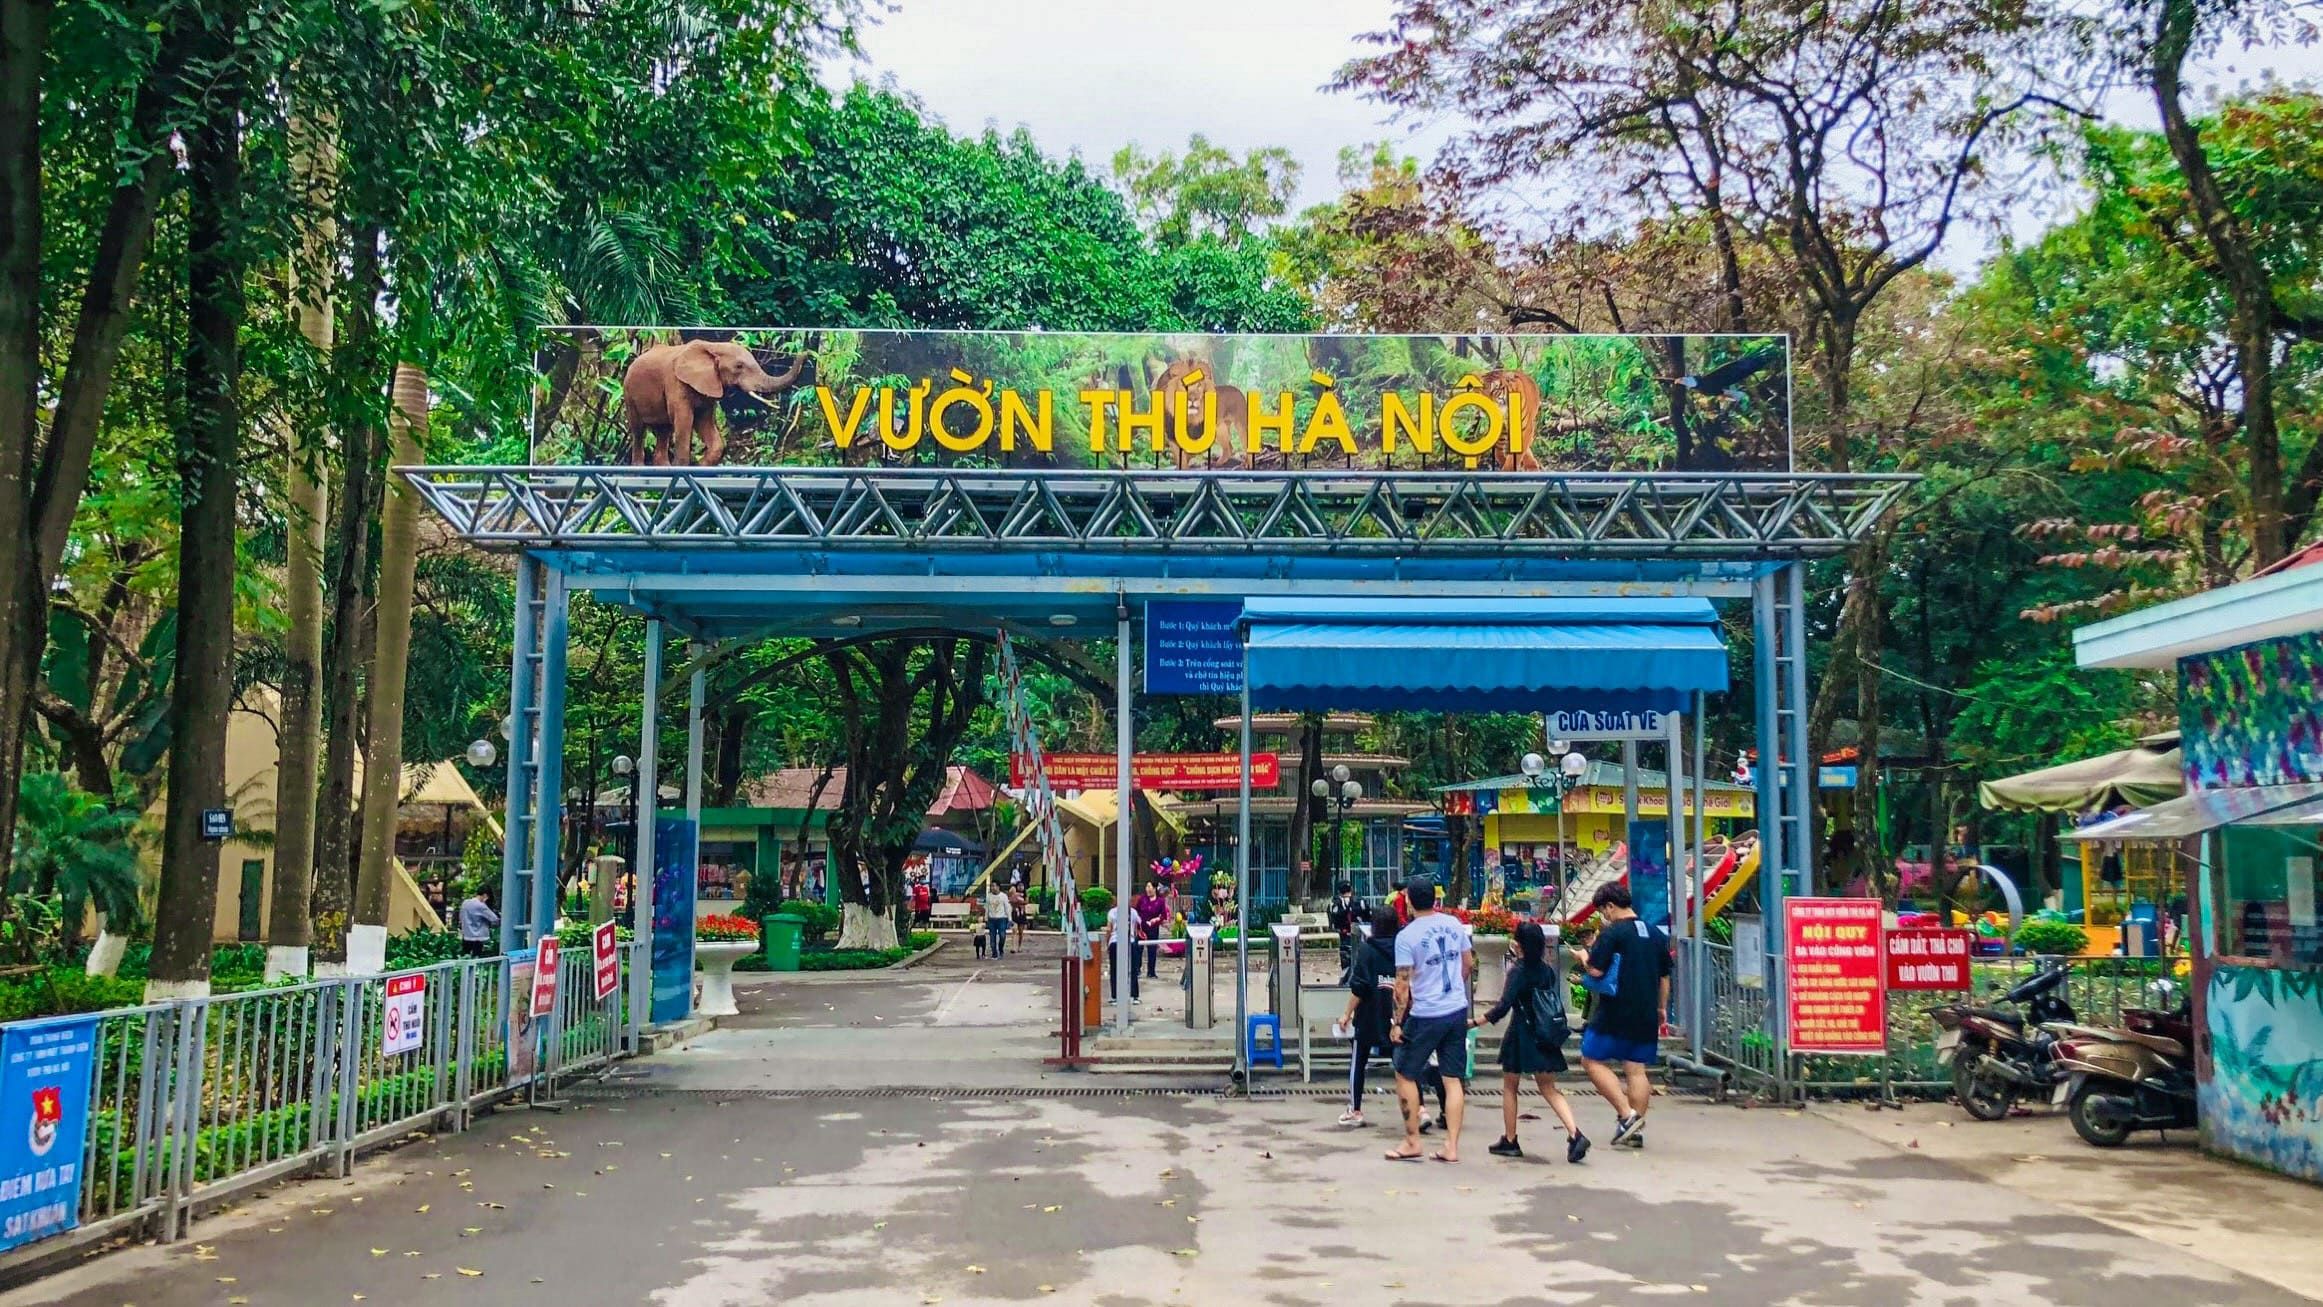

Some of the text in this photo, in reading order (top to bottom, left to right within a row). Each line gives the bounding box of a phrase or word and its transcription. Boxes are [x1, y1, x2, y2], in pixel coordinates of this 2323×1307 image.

[816, 367, 1523, 469] VƯỜN THÚ HÀ NỘI
[1201, 640, 1222, 649] khách
[1835, 926, 1868, 941] QUY
